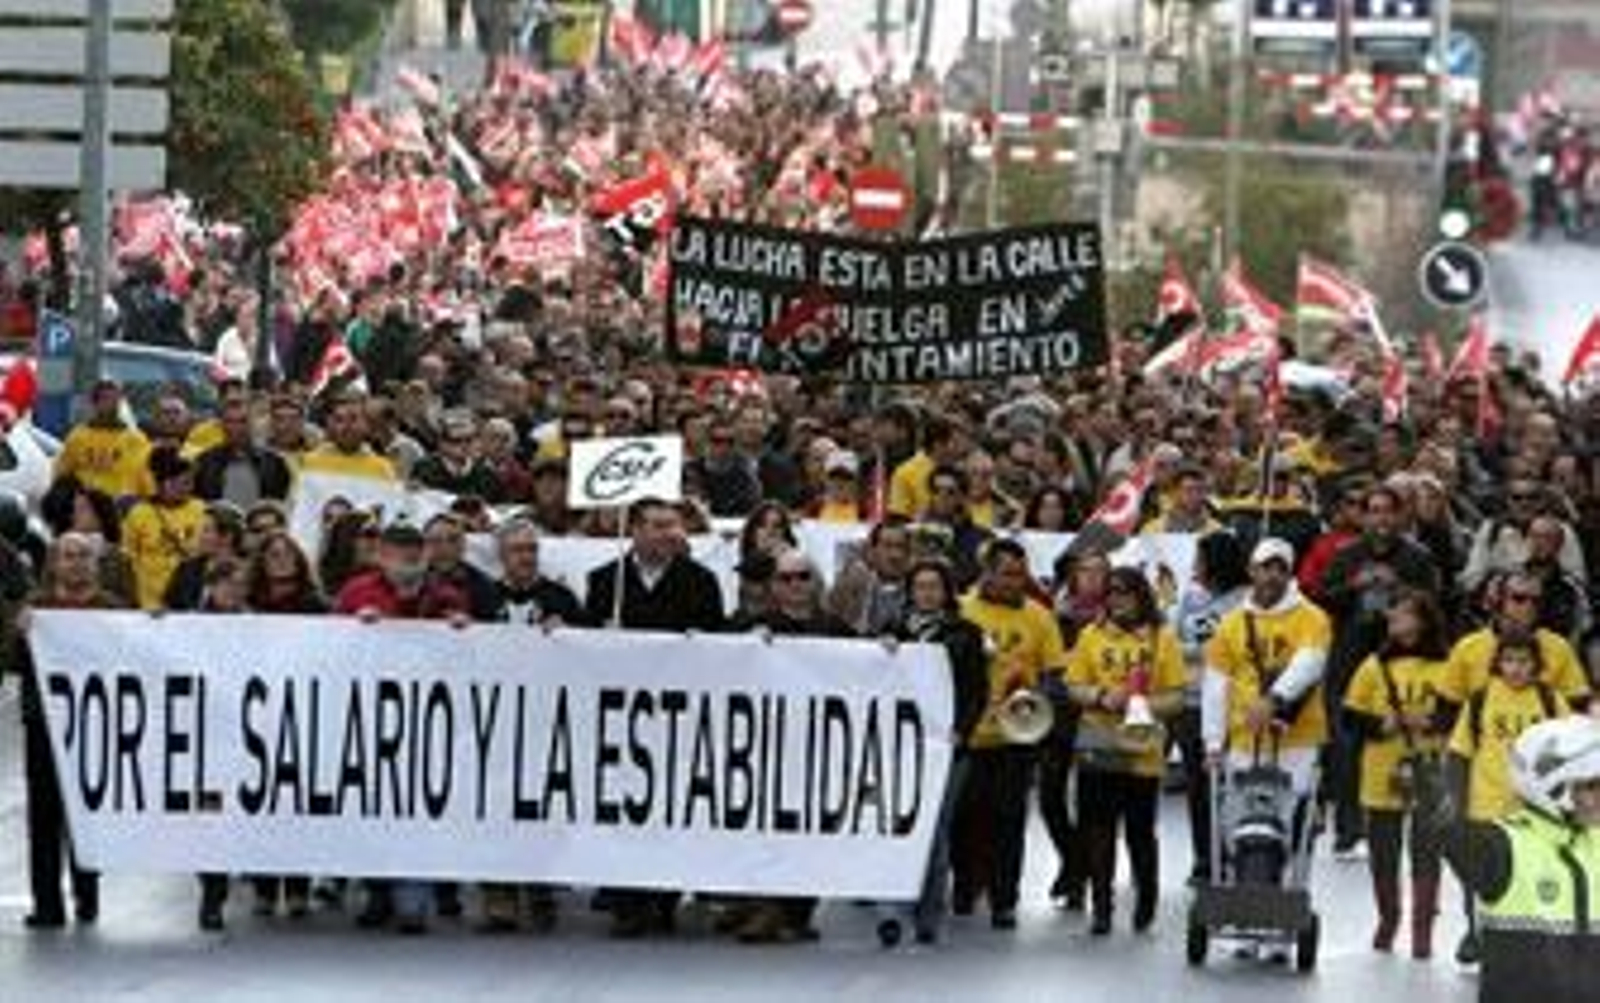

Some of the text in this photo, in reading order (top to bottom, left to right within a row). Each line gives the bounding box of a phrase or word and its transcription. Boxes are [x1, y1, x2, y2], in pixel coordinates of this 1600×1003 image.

[714, 231, 805, 280] LUCHA
[818, 246, 893, 291] ESTA
[904, 253, 949, 290] EN
[956, 244, 1002, 284] LA
[1007, 231, 1098, 277] CALLE
[49, 325, 72, 352] P
[977, 293, 1027, 335] EN
[163, 673, 222, 813] EL
[238, 674, 456, 818] SALARIO
[470, 682, 503, 822] Y
[513, 684, 577, 825] LA
[594, 687, 925, 836] ESTABILIDAD
